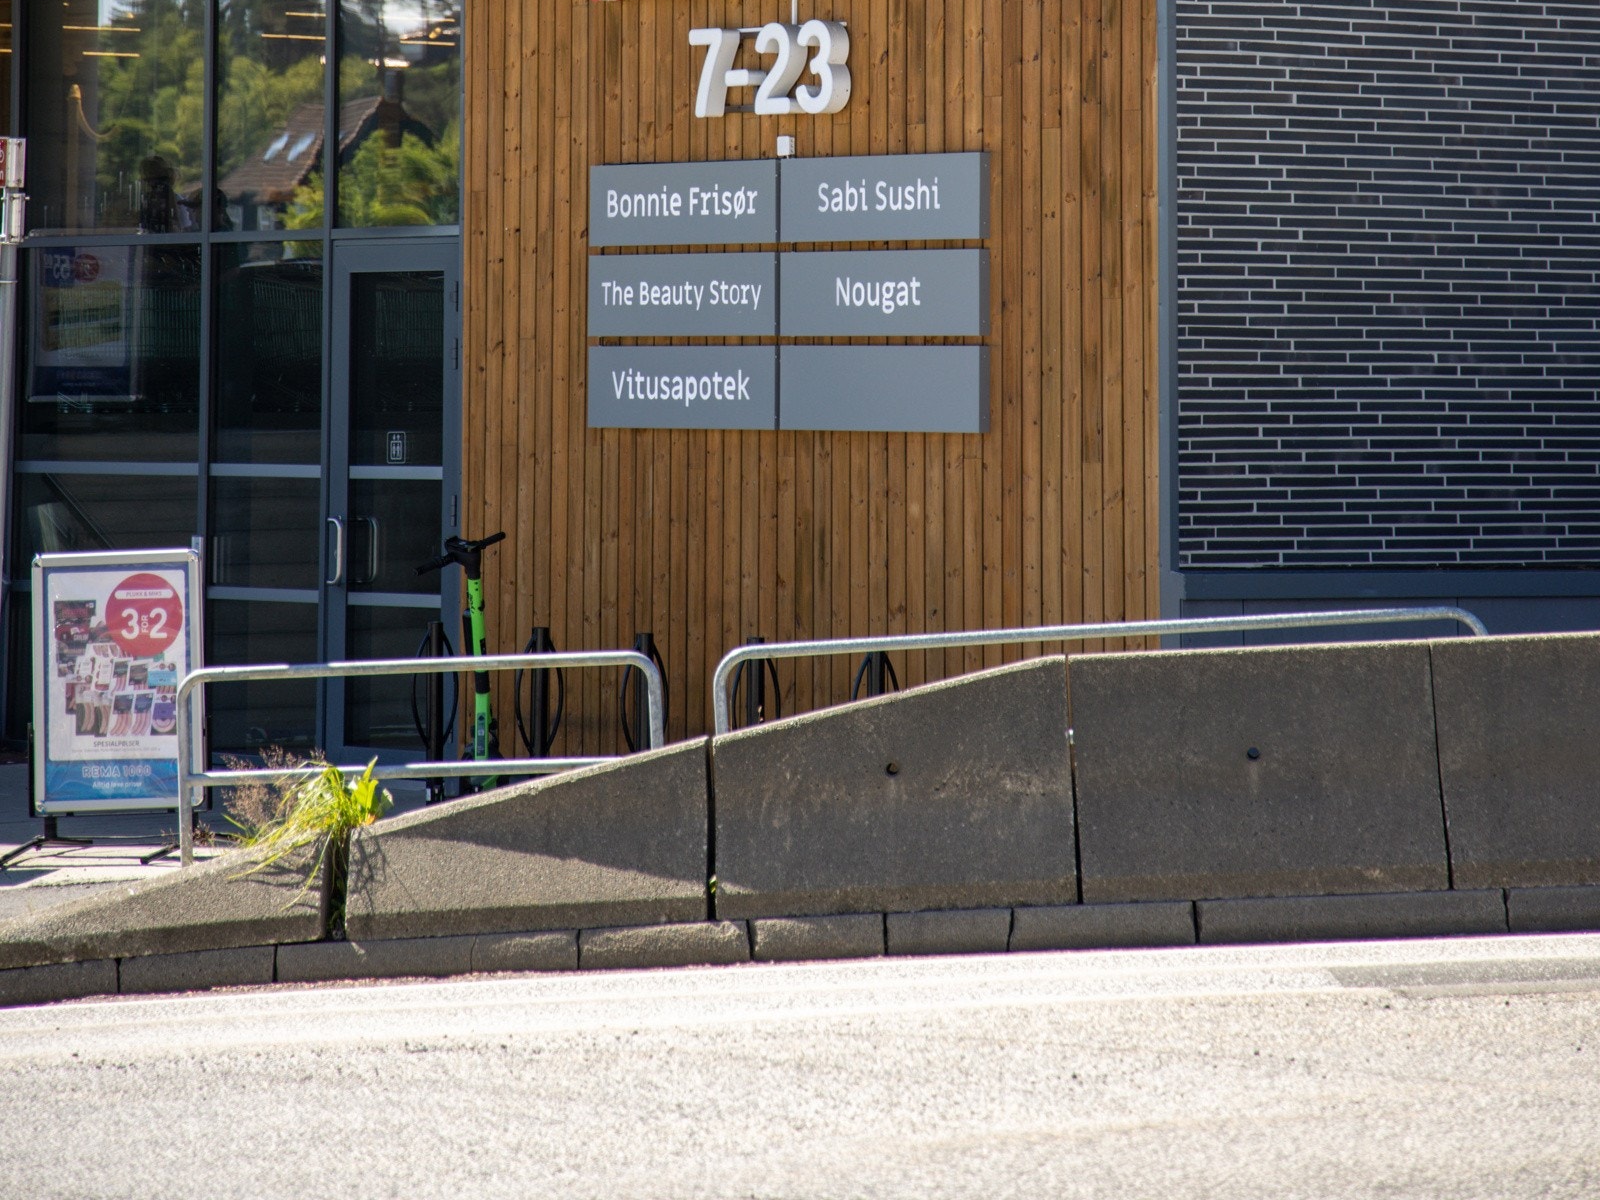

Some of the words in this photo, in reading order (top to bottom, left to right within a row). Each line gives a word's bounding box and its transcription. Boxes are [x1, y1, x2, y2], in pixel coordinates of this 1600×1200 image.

[689, 19, 846, 118] 7-23
[606, 186, 681, 218] Bonnie
[689, 184, 758, 218] Frisør
[817, 179, 868, 212] Sabi
[875, 177, 941, 211] Sushi
[601, 281, 634, 306] The
[639, 281, 704, 311] Beauty
[709, 280, 762, 310] Story
[835, 276, 921, 314] Nougat
[612, 368, 750, 407] Vitusapotek
[121, 608, 140, 639] 3
[141, 614, 149, 633] FOR
[149, 608, 168, 638] 2
[82, 766, 121, 778] REMA
[123, 765, 152, 777] 1000
